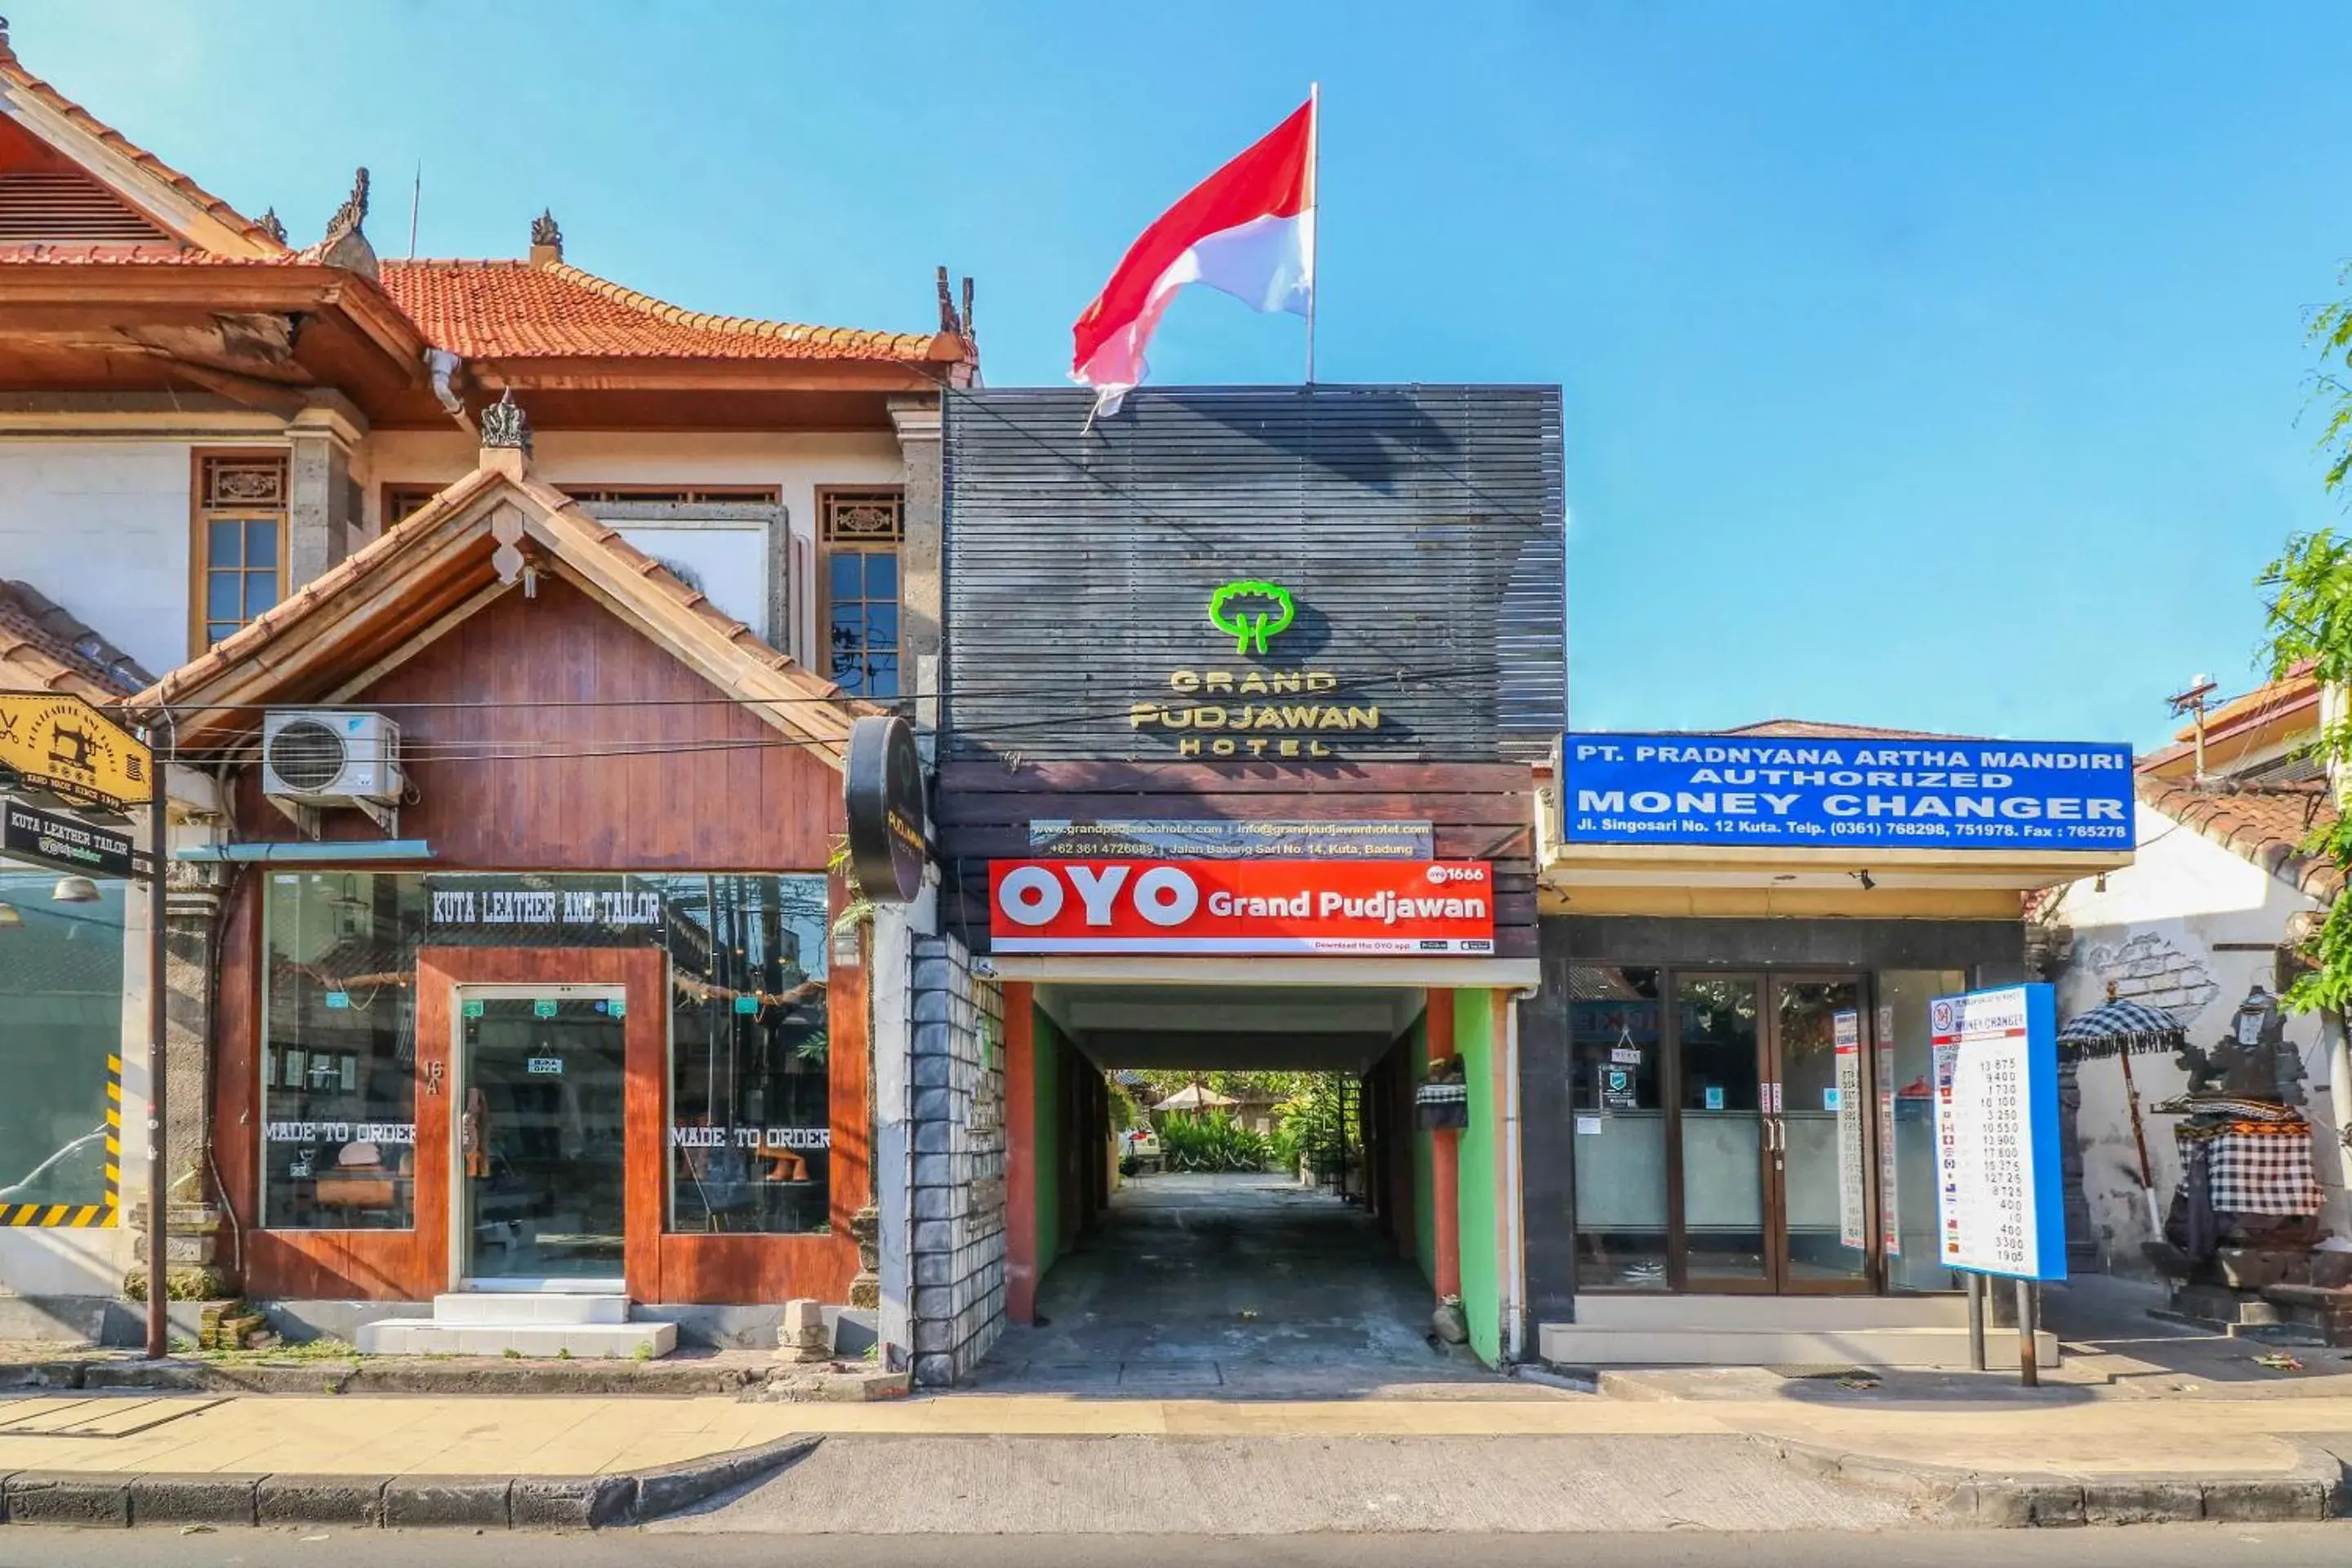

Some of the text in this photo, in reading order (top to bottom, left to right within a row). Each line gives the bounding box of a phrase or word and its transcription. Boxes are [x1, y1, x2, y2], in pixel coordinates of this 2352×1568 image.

[1170, 670, 1337, 694] GRAND
[1130, 702, 1380, 729] PUDJAWAN
[1179, 739, 1330, 756] HOTEL
[1577, 745, 2124, 769] PT. PRADNYANA ARTHA MANDIRI
[1689, 768, 2013, 788] AUTHORIZED
[1577, 790, 2126, 820] MONEY CHANGER
[11, 812, 128, 856] KUTA LEATHER TAILOR
[1577, 818, 1597, 831] Jl.
[1602, 818, 1677, 834] Singosari
[1682, 819, 1709, 832] No.
[1715, 820, 1734, 832] 12
[1739, 820, 1782, 833] Kuta.
[1788, 822, 1826, 837] Telp.
[1831, 822, 1882, 837] (0361)
[1886, 822, 1950, 838] 768298,
[2024, 826, 2053, 837] Fax
[2066, 826, 2127, 838] 765278
[1169, 844, 1204, 854] Jalan
[1206, 844, 1253, 856] Bakung
[1283, 844, 1304, 854] No.
[1329, 844, 1362, 855] Kuta,
[1365, 844, 1414, 856] Badung
[1447, 868, 1485, 881] 1666
[433, 891, 661, 924] KUTA LEATHER AND TAILOR
[998, 866, 1199, 927] OYO
[1209, 890, 1486, 924] Grand Pudjawan
[265, 1122, 417, 1143] MADE TO ORDER
[670, 1127, 831, 1149] MADE TO ORDER
